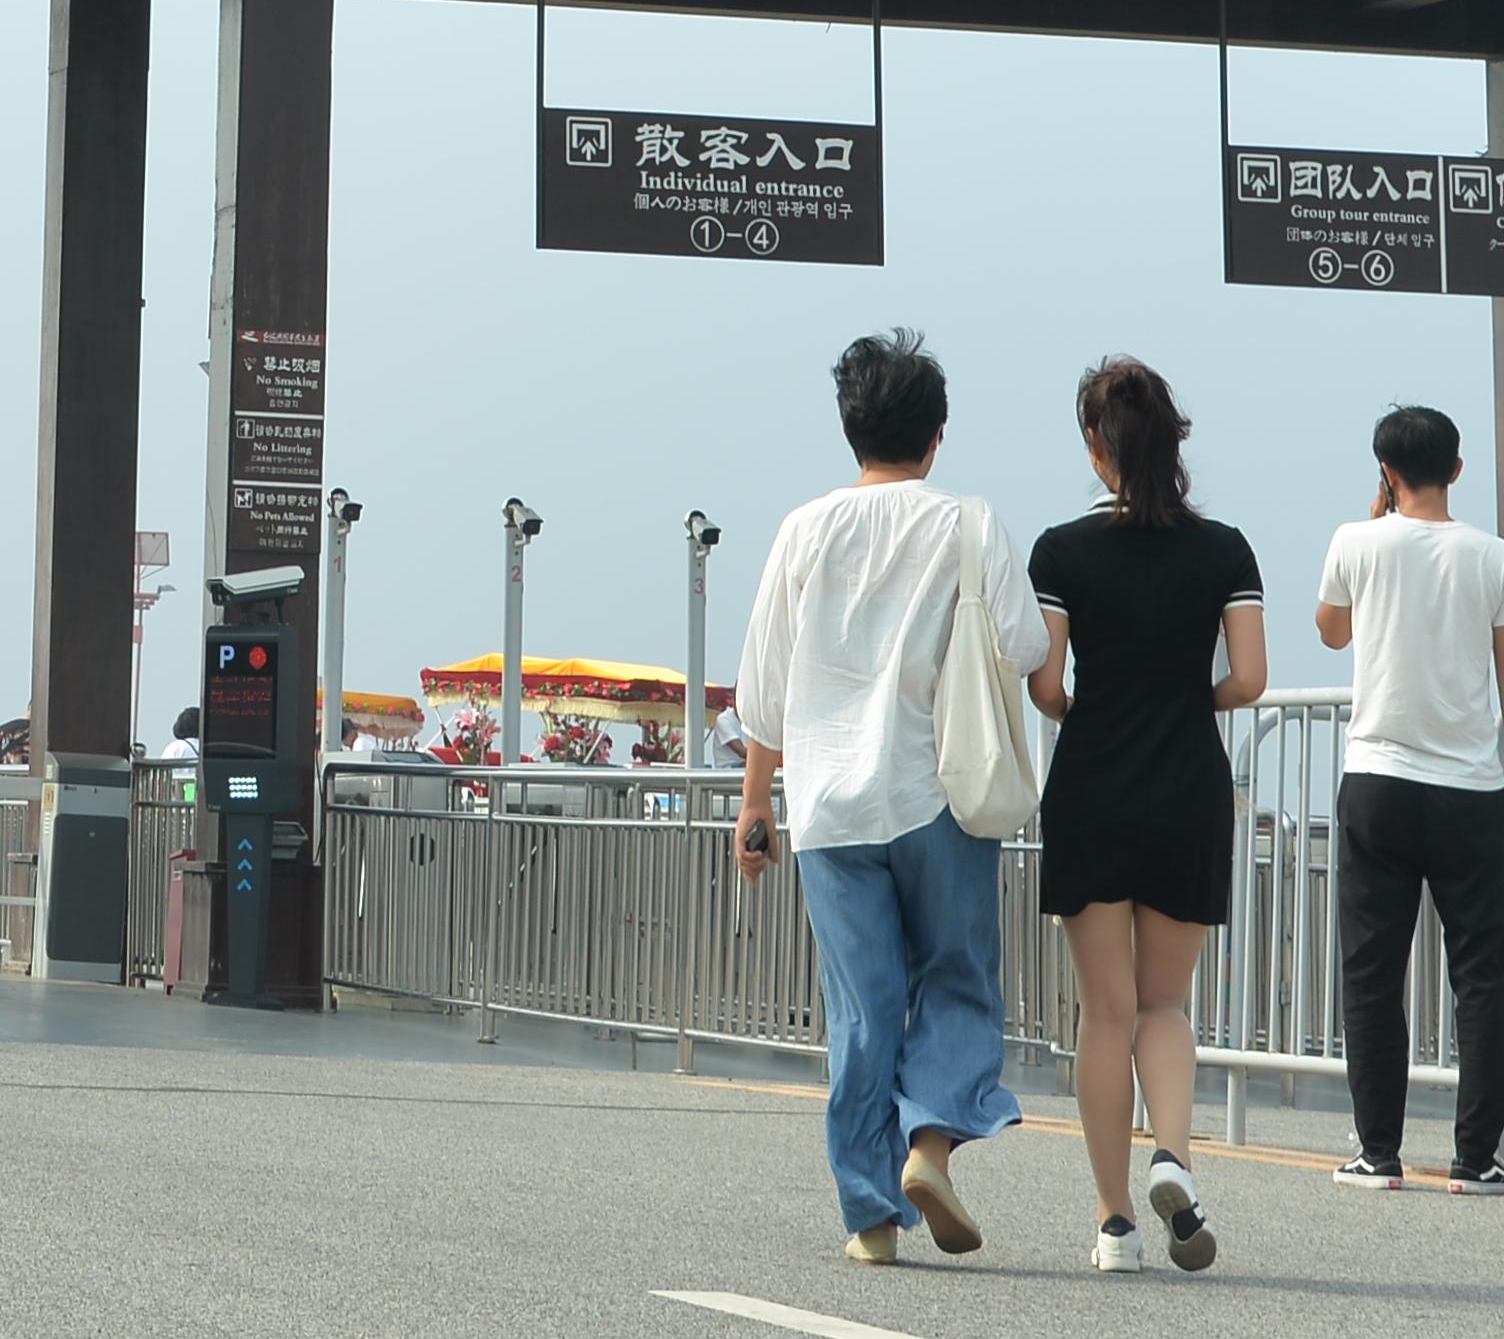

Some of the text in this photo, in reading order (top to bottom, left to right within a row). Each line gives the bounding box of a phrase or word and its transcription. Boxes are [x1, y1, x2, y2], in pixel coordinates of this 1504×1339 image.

[634, 123, 854, 171] 散客入口
[640, 171, 845, 199] Individual entrance
[1289, 160, 1434, 202] 团队入口
[824, 202, 853, 221] 입구
[1290, 204, 1430, 224] Group tour entrance
[1410, 233, 1435, 249] 입구
[263, 356, 321, 374] 禁止吸烟
[256, 375, 319, 390] No Smoking
[253, 442, 312, 456] No Littering
[250, 510, 264, 520] No
[282, 511, 315, 523] Allowed
[334, 557, 342, 573] 1
[512, 566, 522, 583] 2
[694, 578, 704, 595] 3
[219, 645, 236, 670] P
